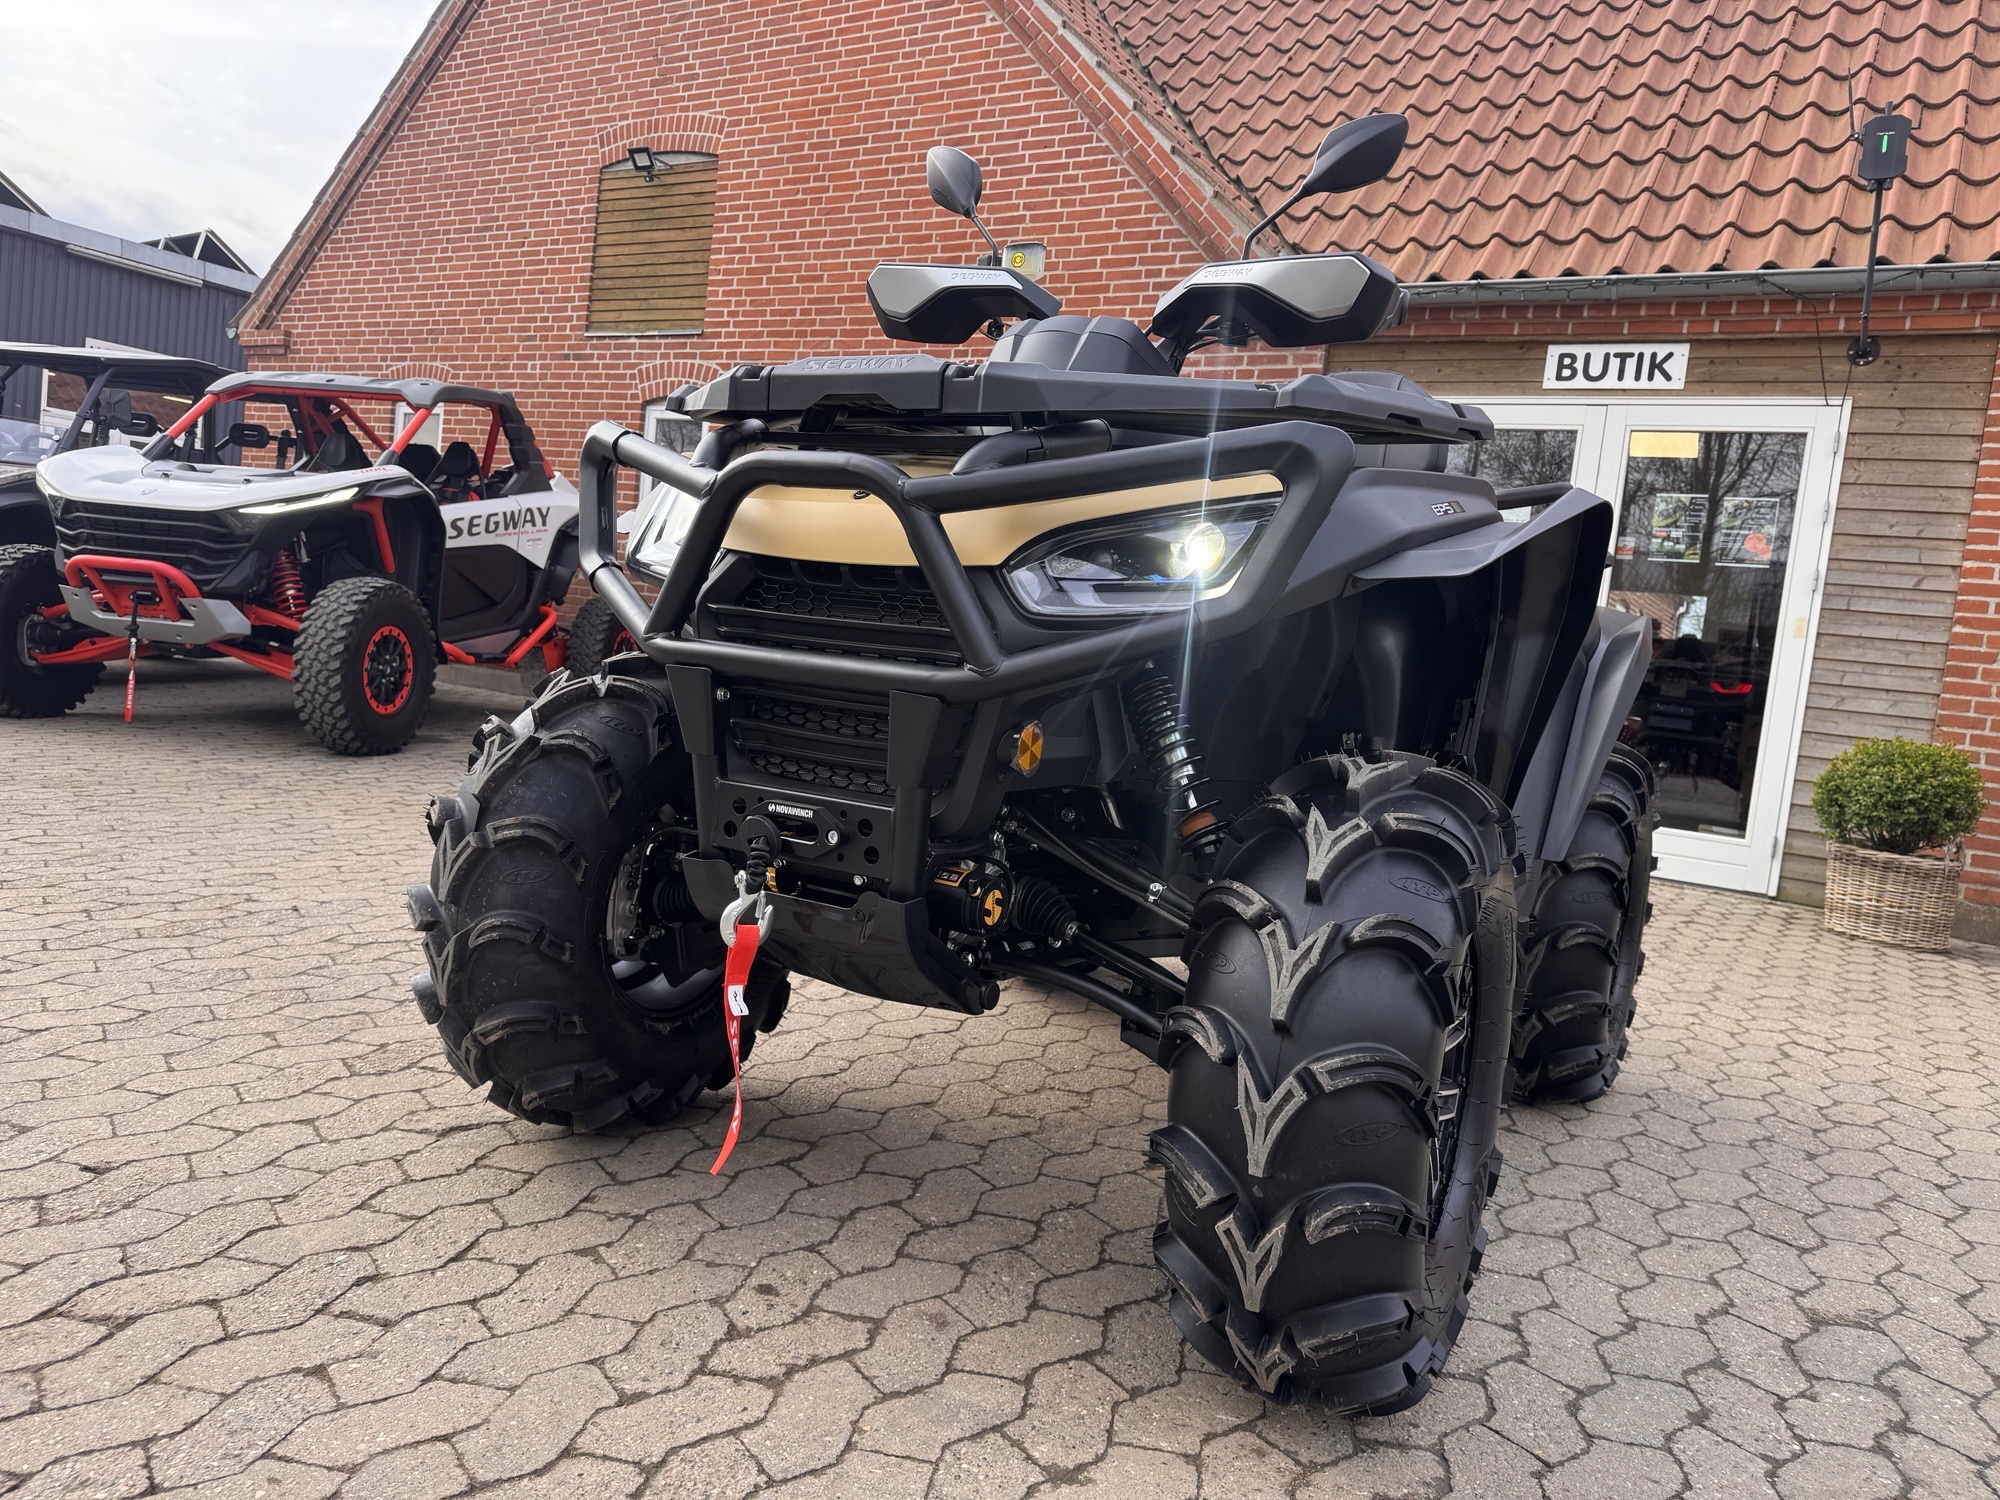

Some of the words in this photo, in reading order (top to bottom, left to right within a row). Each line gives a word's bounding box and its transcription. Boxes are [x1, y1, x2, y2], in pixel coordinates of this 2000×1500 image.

[951, 272, 1002, 281] SEGWAY
[1203, 267, 1254, 278] SEGWAY
[802, 356, 916, 371] SEGWAY
[1555, 351, 1675, 382] BUTIK
[1430, 502, 1455, 516] EPS
[447, 506, 551, 540] SEGWAY
[775, 804, 814, 819] NOVAWINCH
[1402, 878, 1440, 897] ITP
